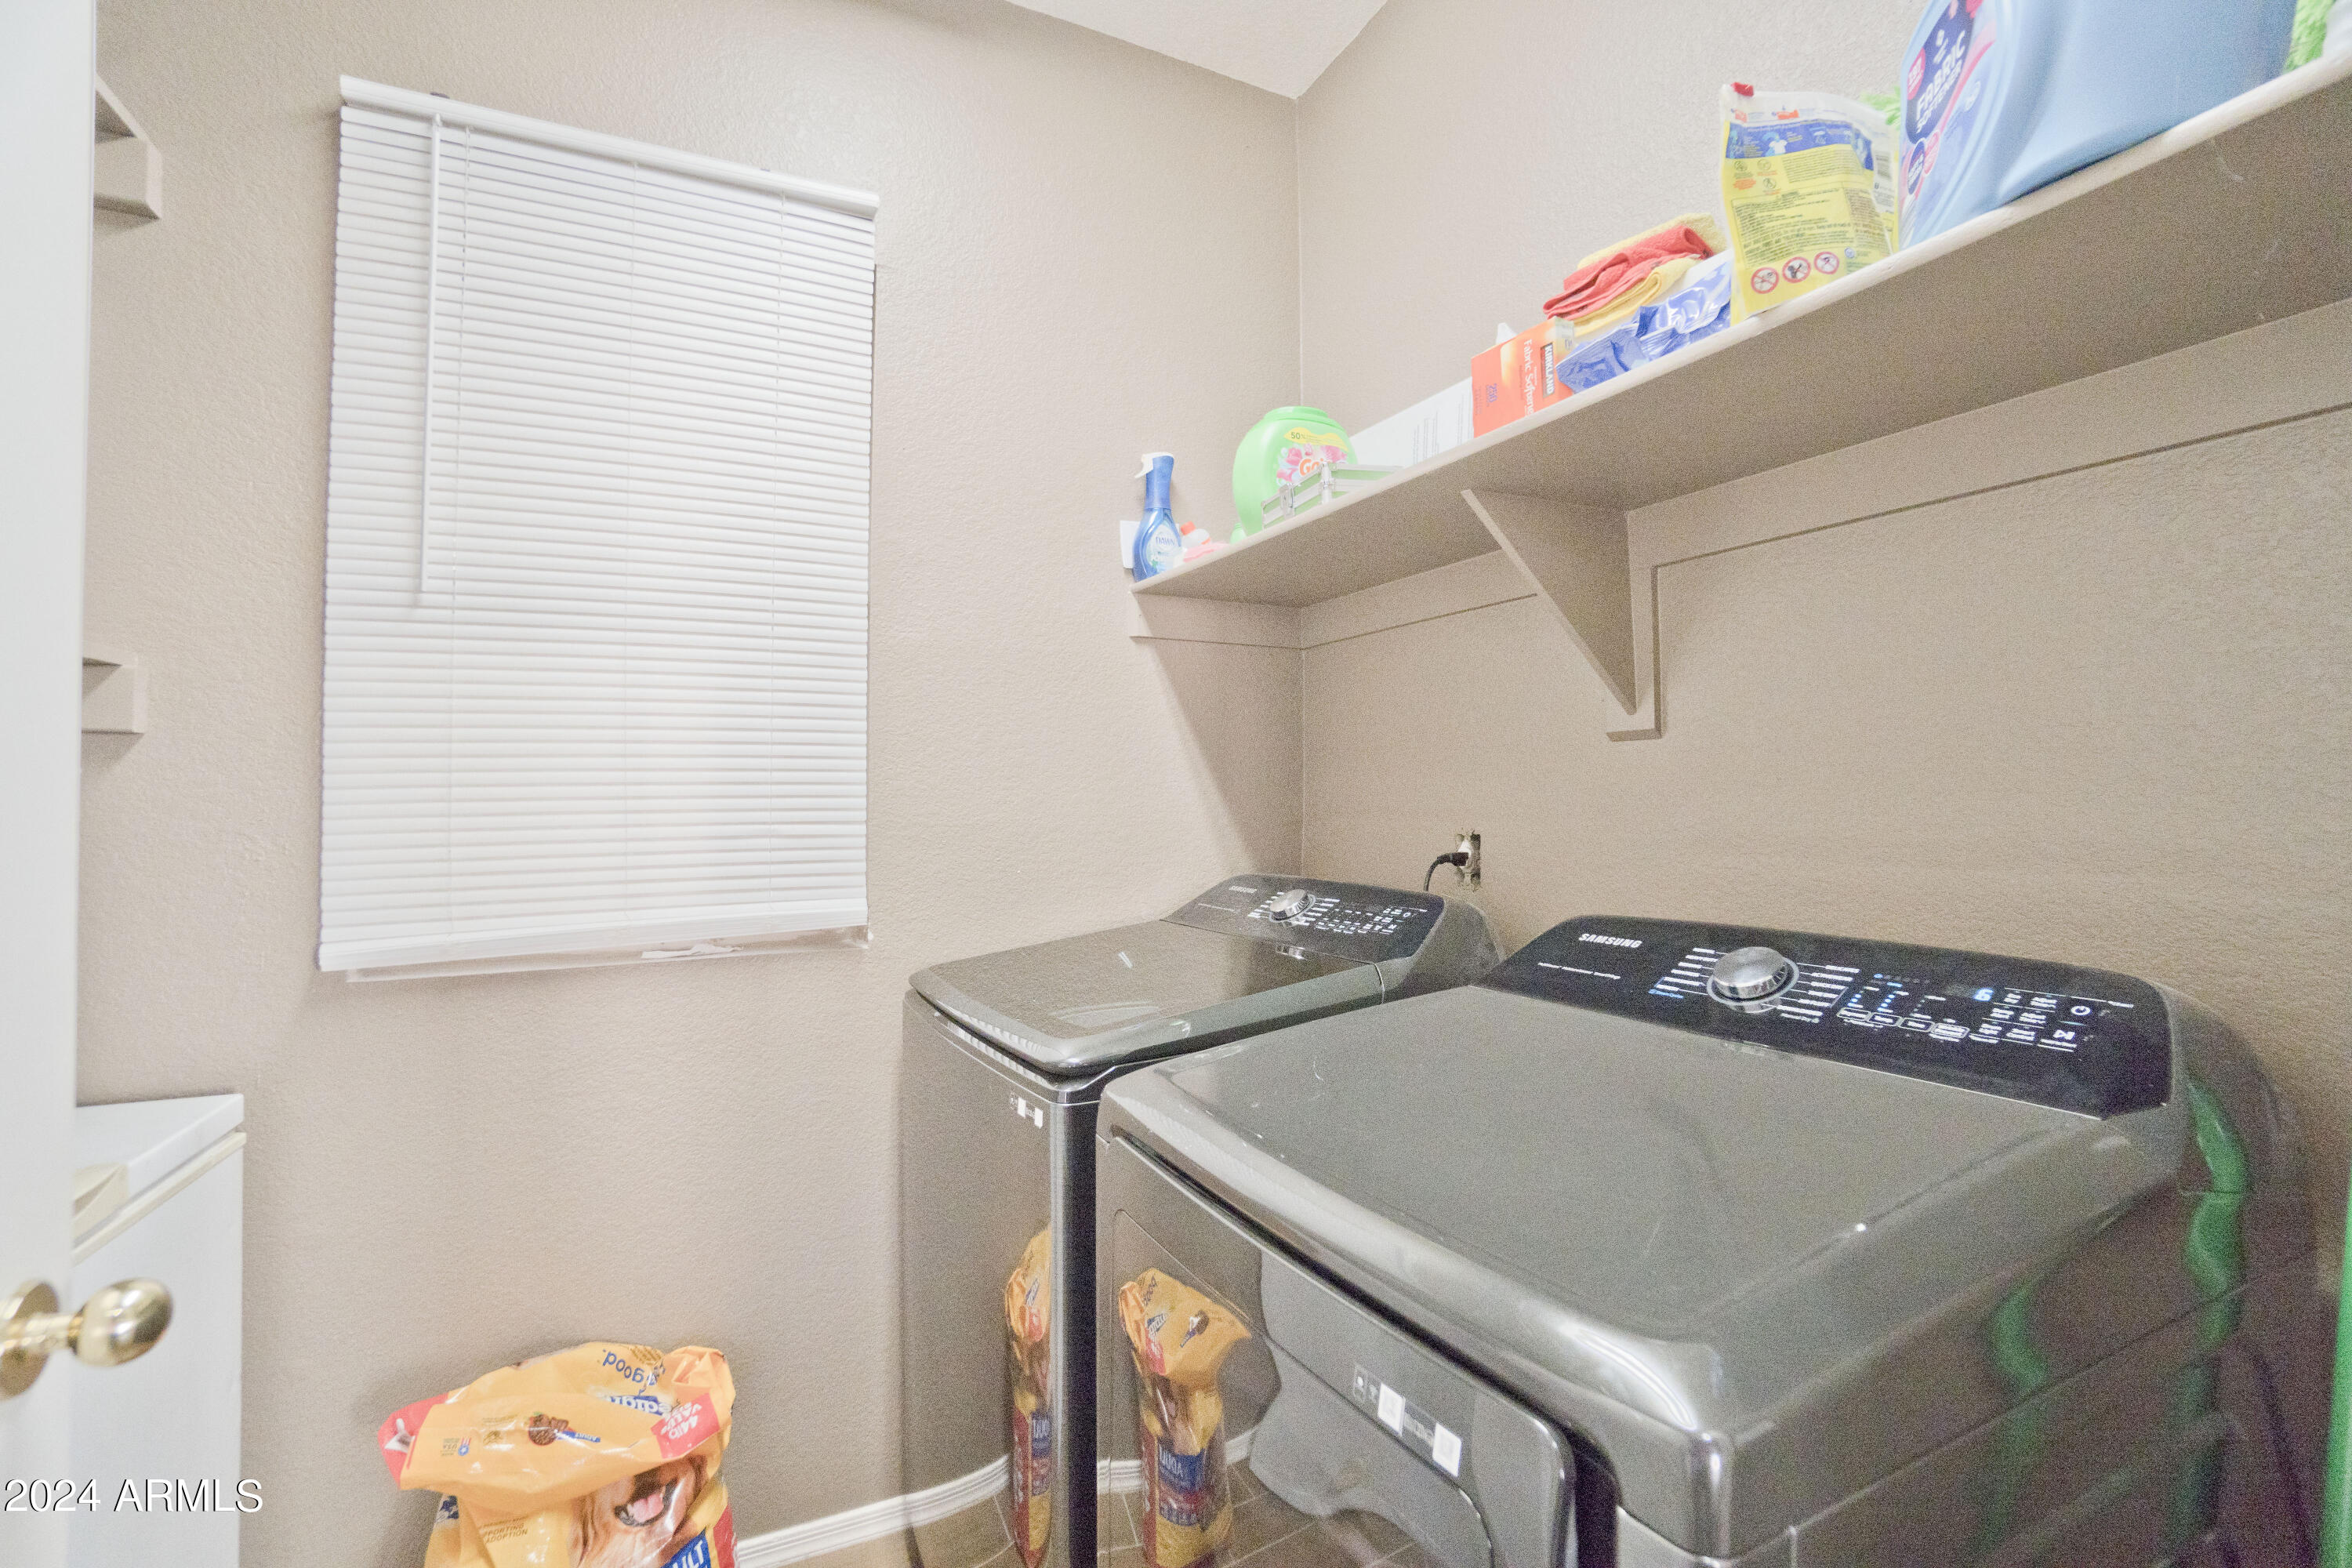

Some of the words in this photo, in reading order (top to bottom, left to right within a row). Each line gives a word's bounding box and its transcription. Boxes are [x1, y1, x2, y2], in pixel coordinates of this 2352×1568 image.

[1916, 30, 1965, 121] FABRIC
[1523, 339, 1534, 372] Fabric
[1544, 343, 1555, 394] KIRKLAND
[1156, 536, 1175, 546] DAWN
[1578, 933, 1643, 949] SAMSUNG
[601, 1348, 645, 1384] good.
[671, 1540, 705, 1568] ULT
